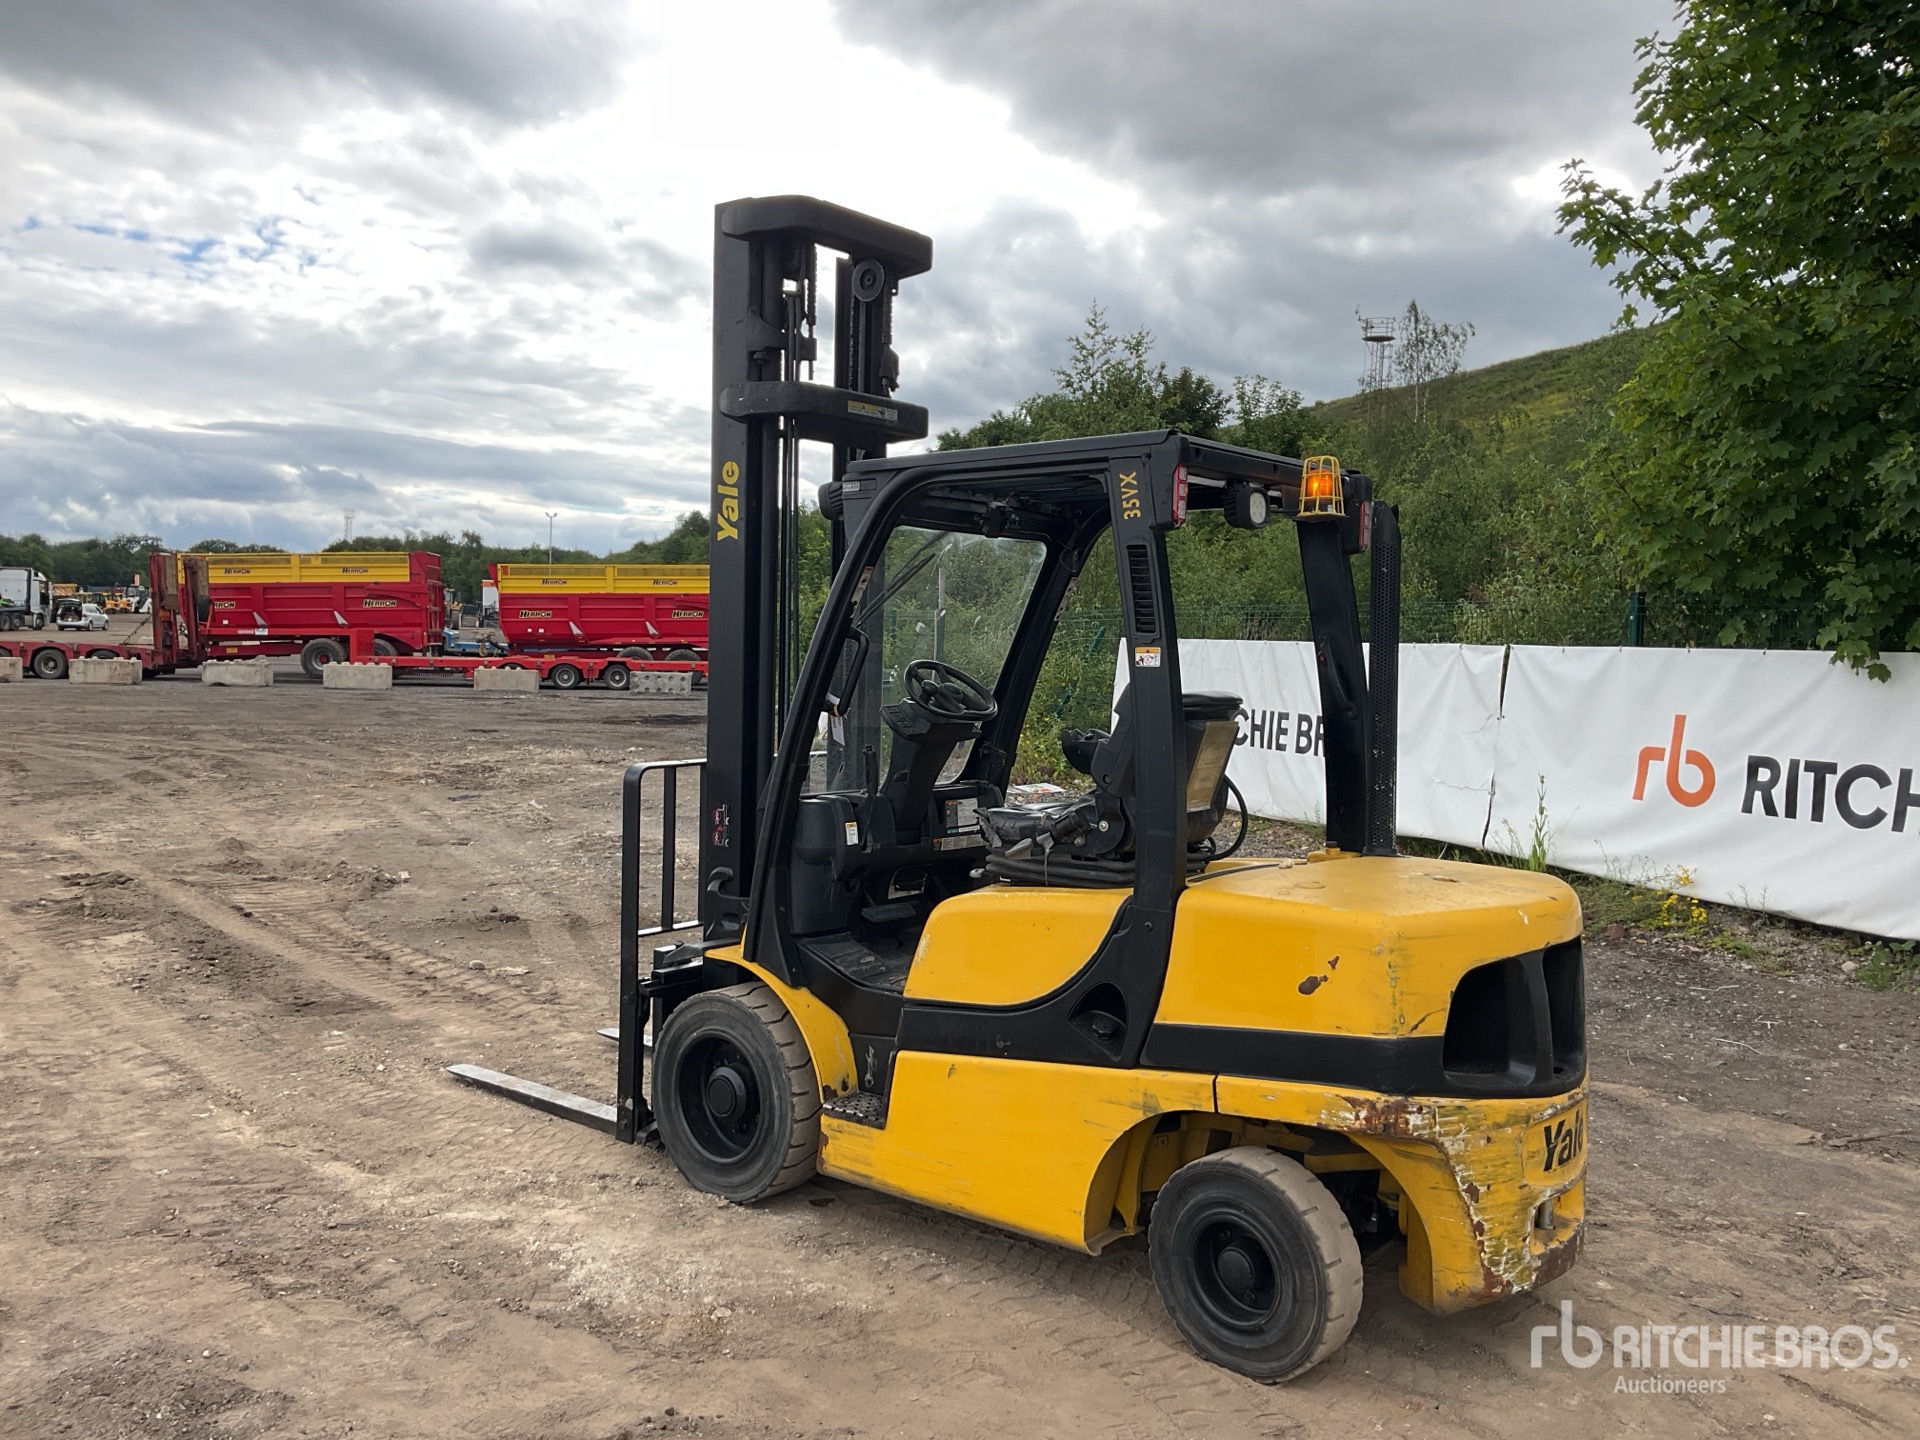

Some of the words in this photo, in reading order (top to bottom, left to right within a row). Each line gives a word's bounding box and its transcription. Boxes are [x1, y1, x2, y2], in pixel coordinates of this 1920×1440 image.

[717, 461, 739, 541] Yale
[1119, 471, 1141, 520] 35VX
[364, 599, 397, 608] HERRON
[519, 610, 552, 618] HERRON
[672, 610, 704, 618] HERRON
[1543, 1110, 1583, 1172] Yale
